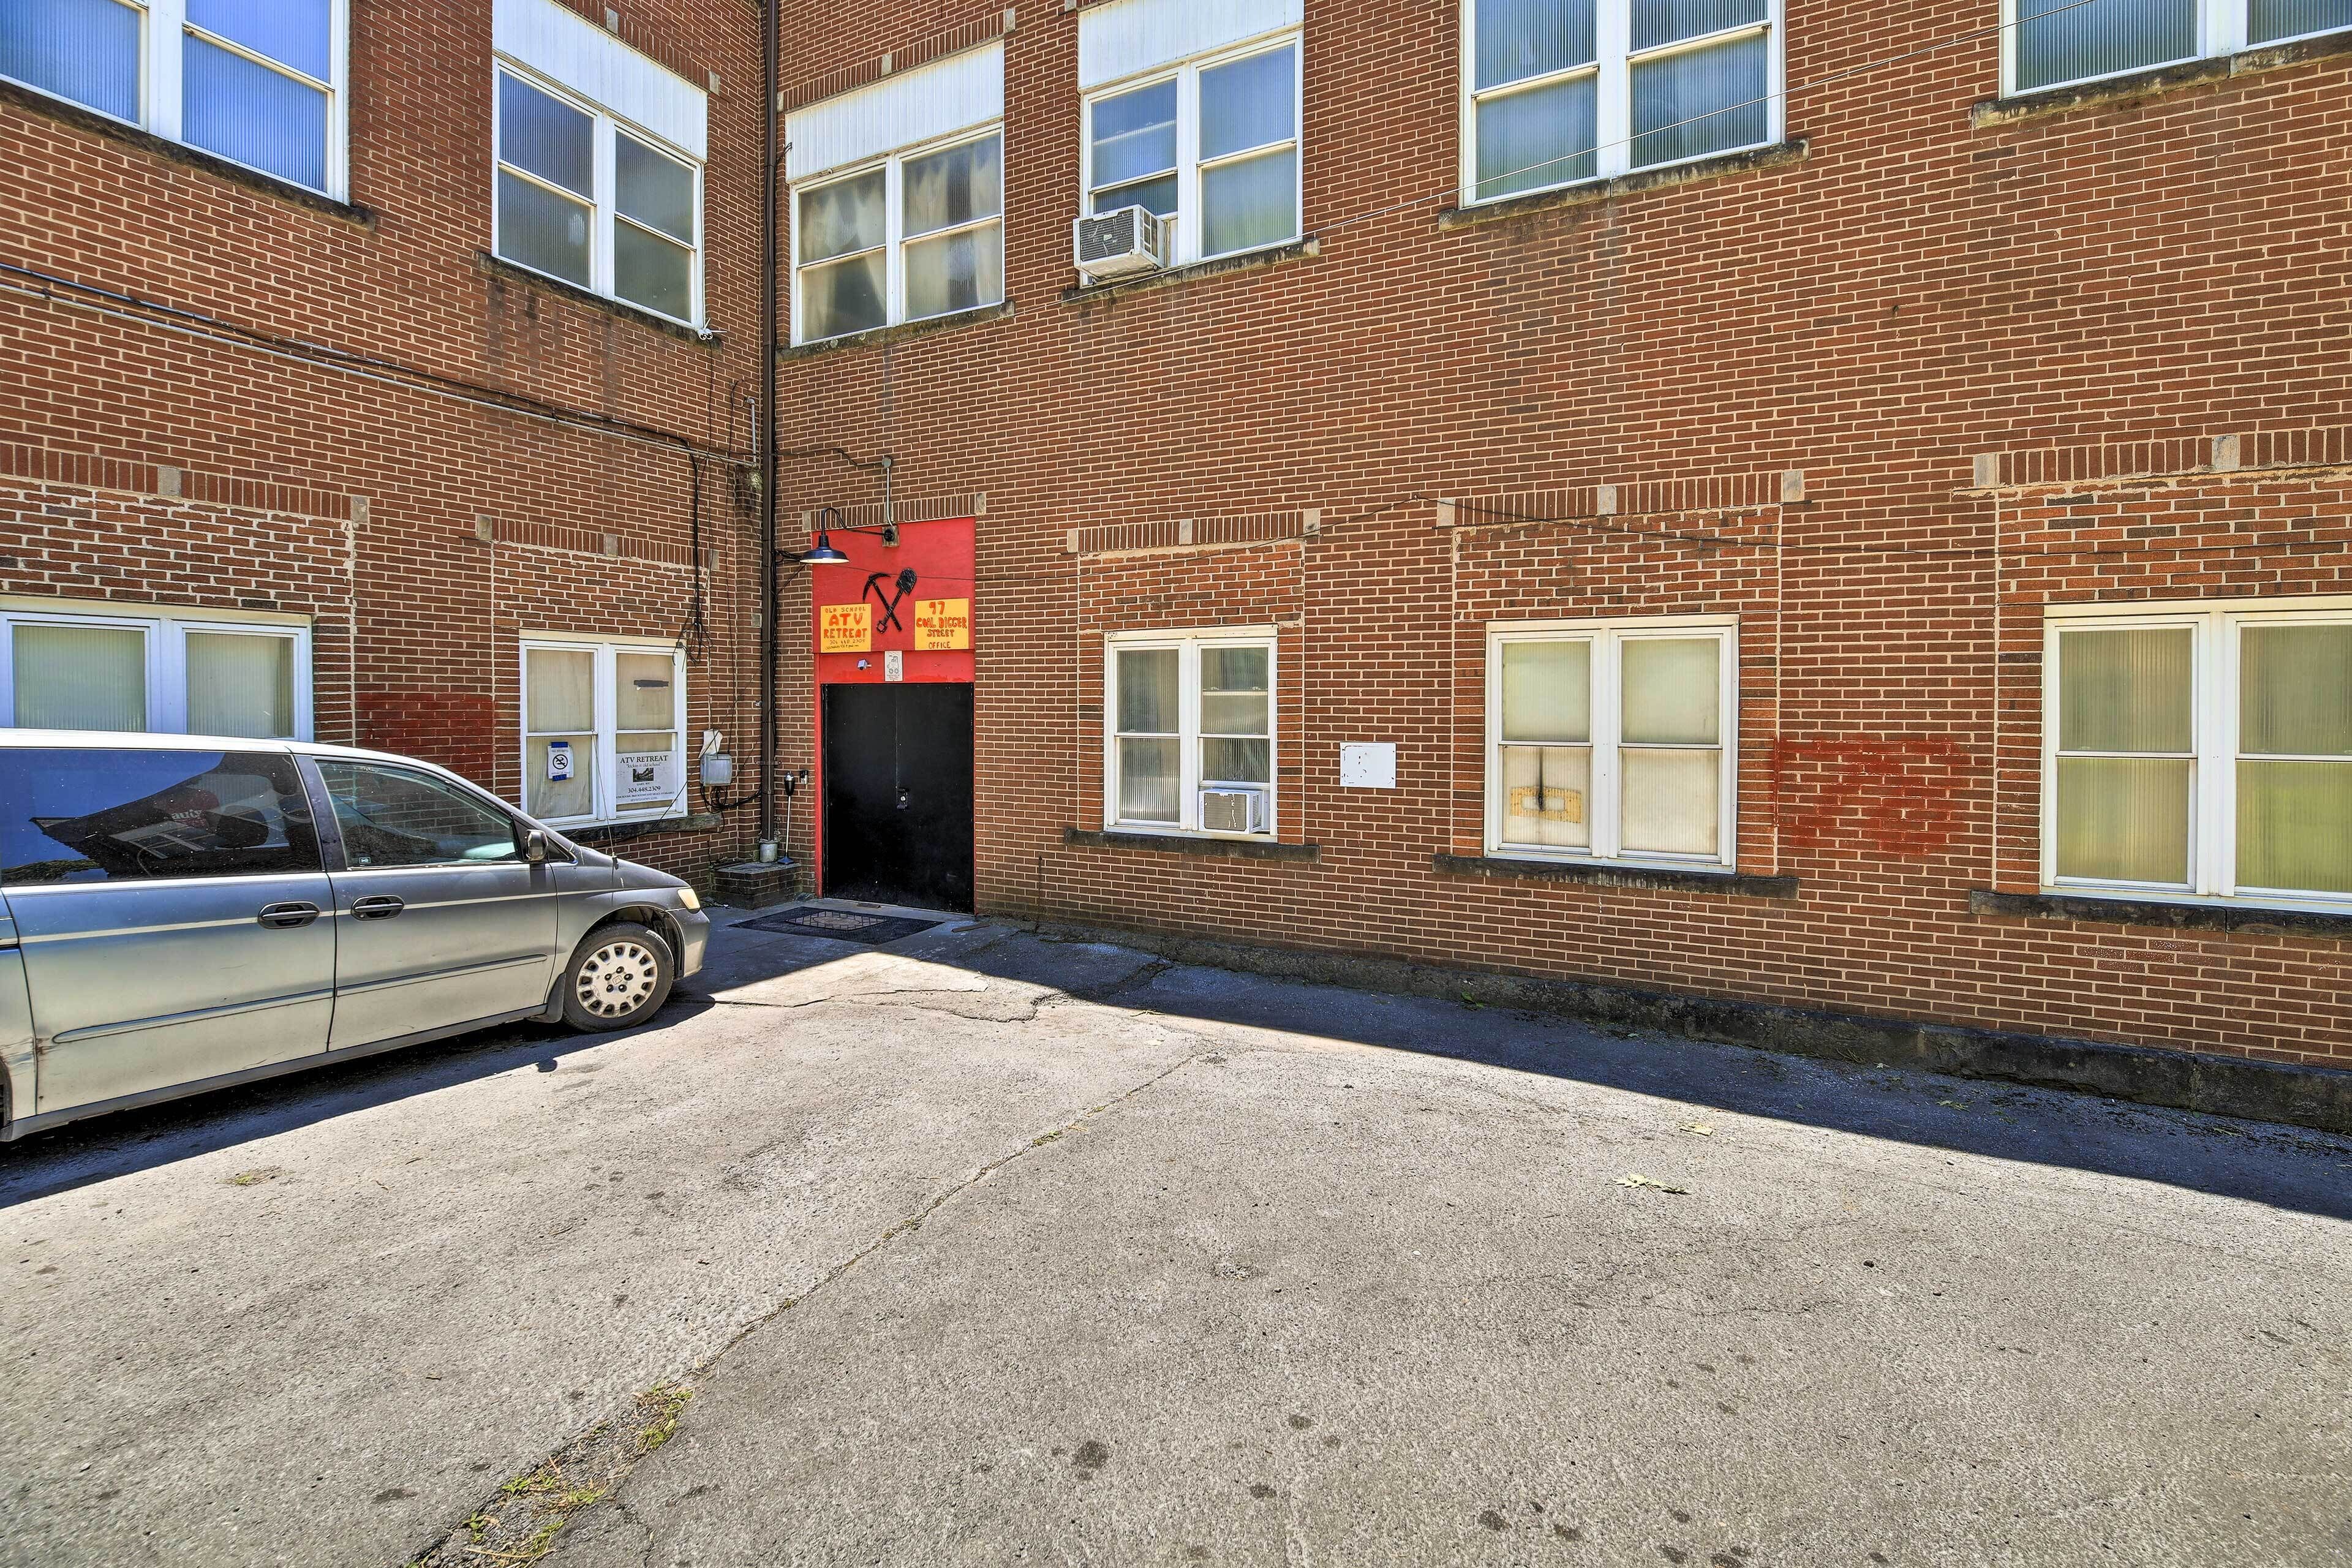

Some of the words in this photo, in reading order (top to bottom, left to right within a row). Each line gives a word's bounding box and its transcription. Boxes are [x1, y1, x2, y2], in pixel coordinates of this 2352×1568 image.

[929, 601, 945, 615] 97
[829, 613, 863, 626] ATV
[916, 617, 937, 628] COAL
[938, 616, 967, 628] DIGGER
[823, 628, 867, 638] RETREAT
